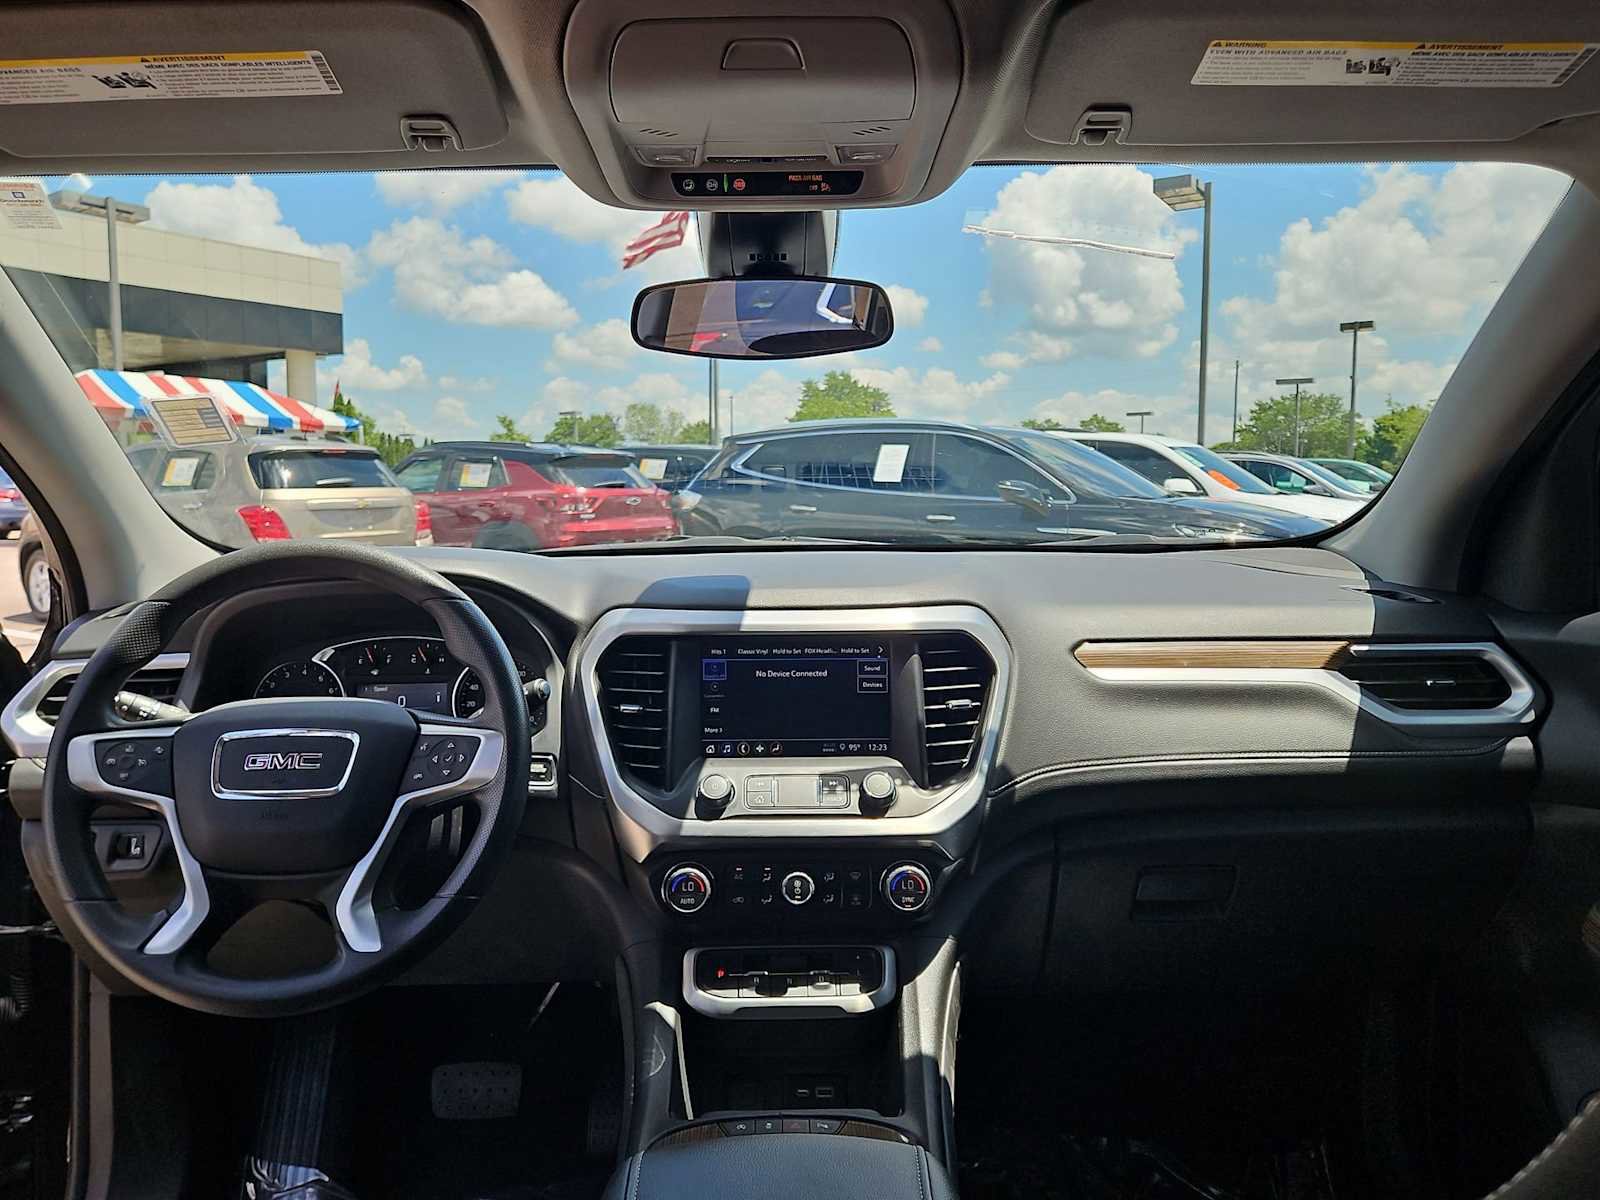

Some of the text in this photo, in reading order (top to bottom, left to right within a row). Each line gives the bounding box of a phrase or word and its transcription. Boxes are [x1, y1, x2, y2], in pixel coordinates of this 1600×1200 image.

[791, 670, 828, 678] Connected
[398, 696, 406, 708] 0
[244, 752, 322, 770] GMC
[682, 881, 694, 892] LO
[902, 880, 914, 890] LO
[717, 969, 724, 978] P
